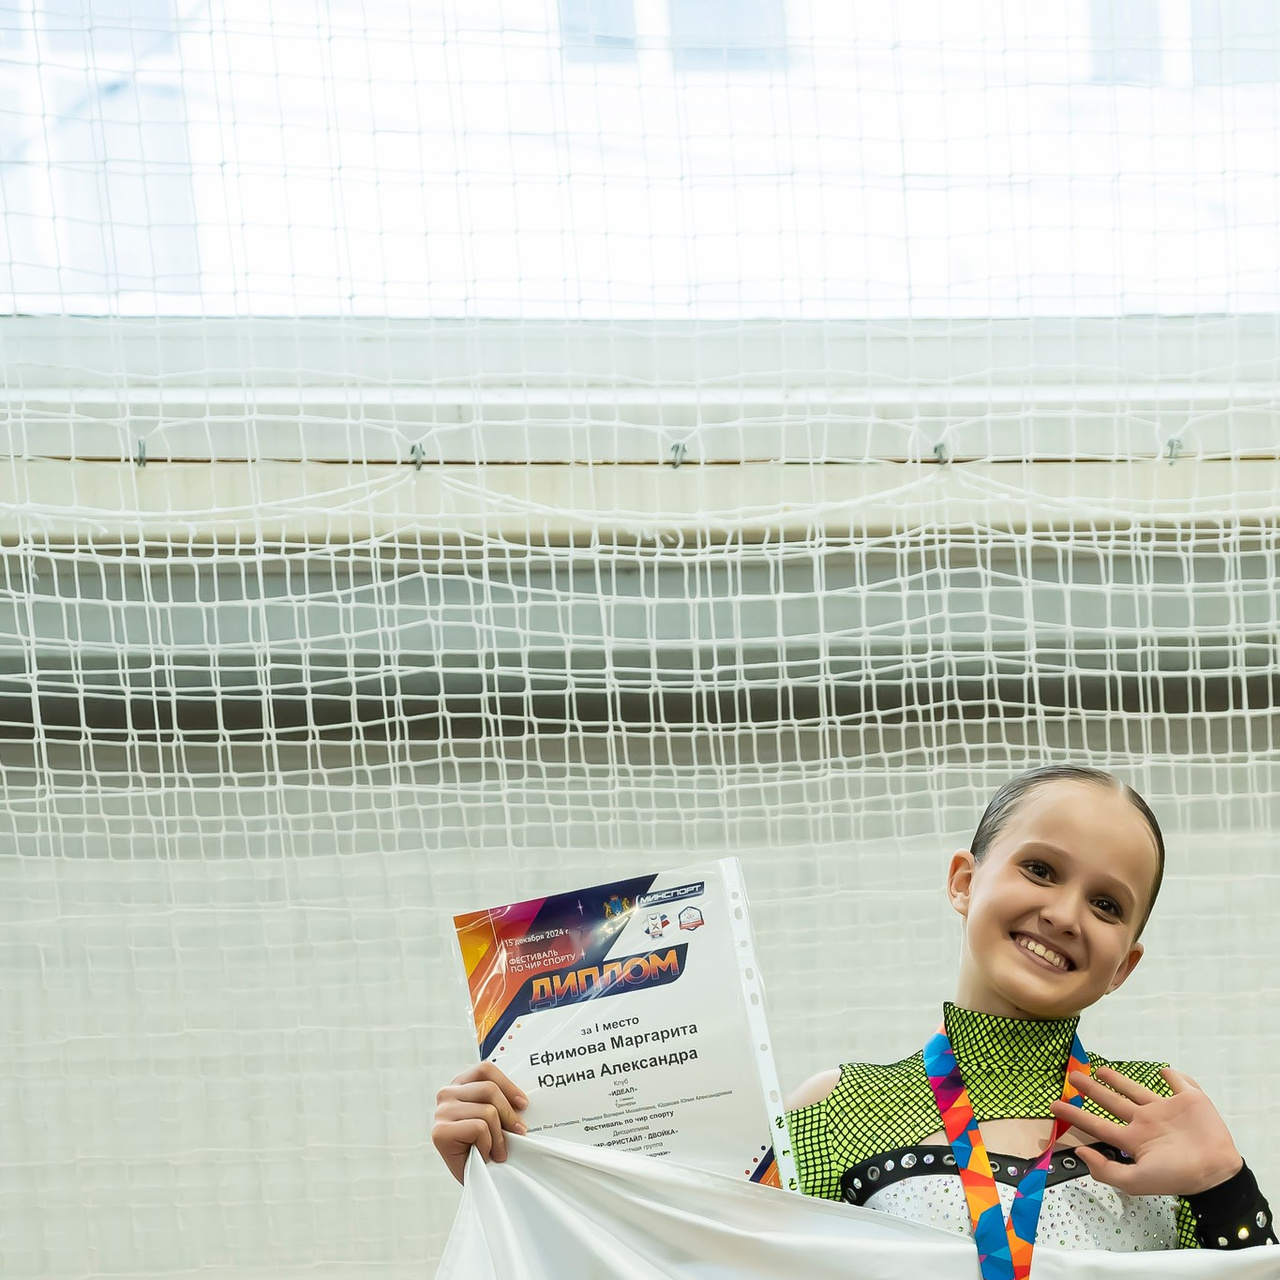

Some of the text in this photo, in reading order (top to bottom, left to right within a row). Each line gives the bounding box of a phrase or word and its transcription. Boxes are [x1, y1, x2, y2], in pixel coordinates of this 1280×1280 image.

[640, 885, 701, 904] МИНСПОРТ
[505, 939, 514, 948] 15
[514, 934, 545, 946] декабря
[545, 928, 564, 939] 2024
[508, 949, 559, 965] ФЕСТИВАЛЬ
[510, 953, 576, 973] ПО ЧИР СПОРТУ
[529, 948, 680, 1011] ДИПЛОМ
[581, 1027, 592, 1036] за
[603, 1016, 640, 1031] место
[530, 1023, 698, 1066] Ефимова Маргарита
[538, 1049, 698, 1088] Юдина Александра
[613, 1078, 629, 1087] Клуб
[583, 1120, 624, 1132] Фестиваль
[635, 1115, 649, 1123] чир
[649, 1110, 674, 1120] спорту
[612, 1125, 650, 1137] Дисциплина
